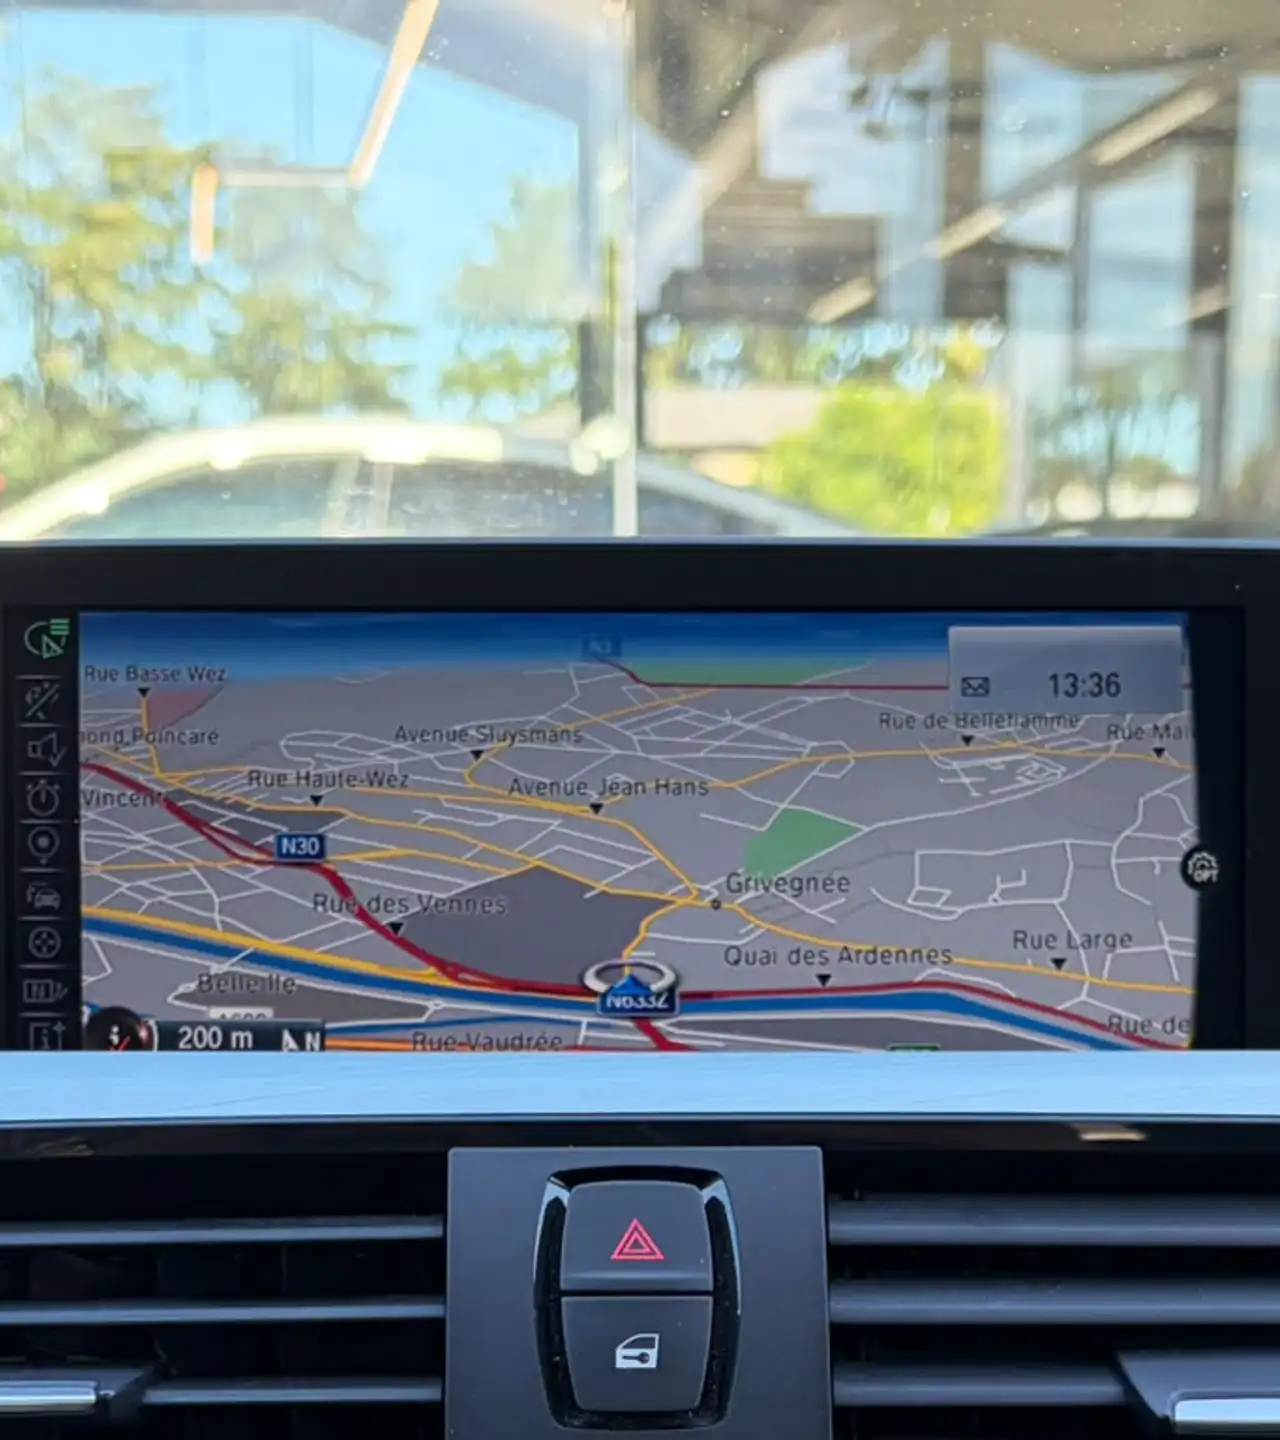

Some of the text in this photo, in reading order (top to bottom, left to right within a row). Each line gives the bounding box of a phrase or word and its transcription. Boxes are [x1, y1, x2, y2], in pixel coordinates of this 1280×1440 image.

[85, 665, 227, 682] Rue Basse Wez
[1048, 672, 1121, 698] 13:36
[878, 712, 917, 730] Rue
[924, 712, 948, 729] de
[132, 727, 219, 745] Poincaré
[394, 723, 469, 742] Avenue
[1107, 723, 1145, 741] Rue
[247, 768, 410, 789] Rue Haute-Wez
[508, 777, 710, 798] Avenue Jean Hans
[281, 837, 320, 856] N30
[725, 871, 851, 896] Grivegnée
[312, 893, 507, 916] Rue des Vennes
[1012, 929, 1133, 956] Rue Large
[723, 944, 954, 967] Quai des Ardennes
[1107, 1014, 1191, 1035] Rue de
[179, 1025, 255, 1050] 200 m
